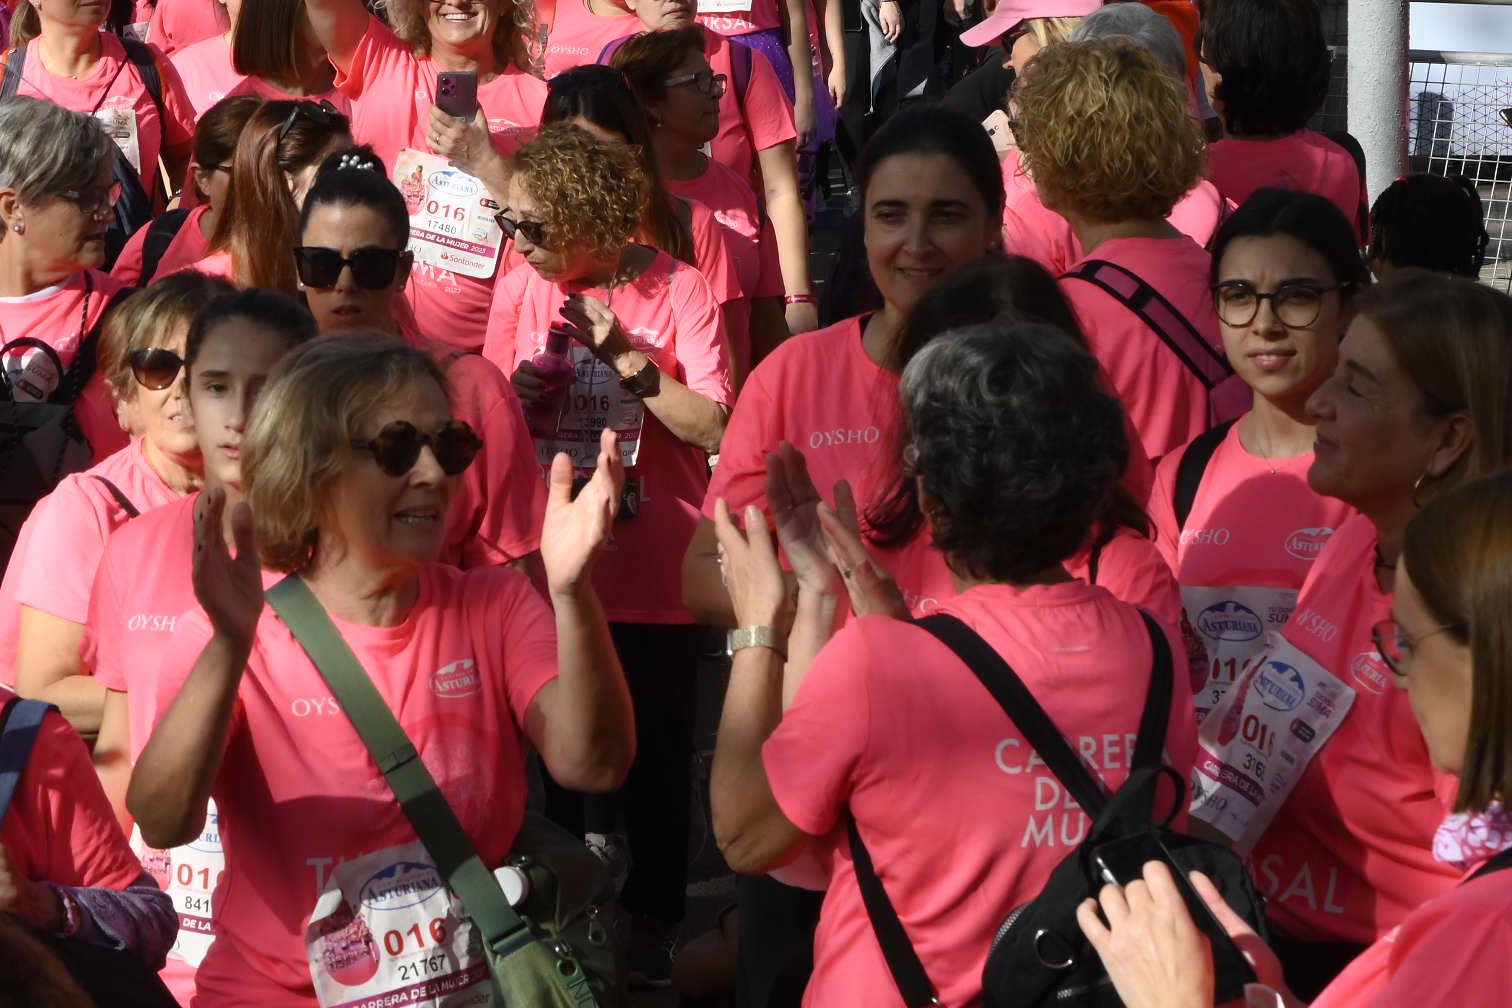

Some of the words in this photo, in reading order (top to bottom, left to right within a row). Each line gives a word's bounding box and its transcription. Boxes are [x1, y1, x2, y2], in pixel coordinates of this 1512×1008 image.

[426, 200, 466, 221] 016
[427, 220, 457, 234] 17480
[809, 427, 880, 450] OYSHO
[182, 918, 197, 931] DE
[383, 917, 448, 957] 016
[398, 954, 446, 981] 21767
[410, 986, 426, 1000] DE
